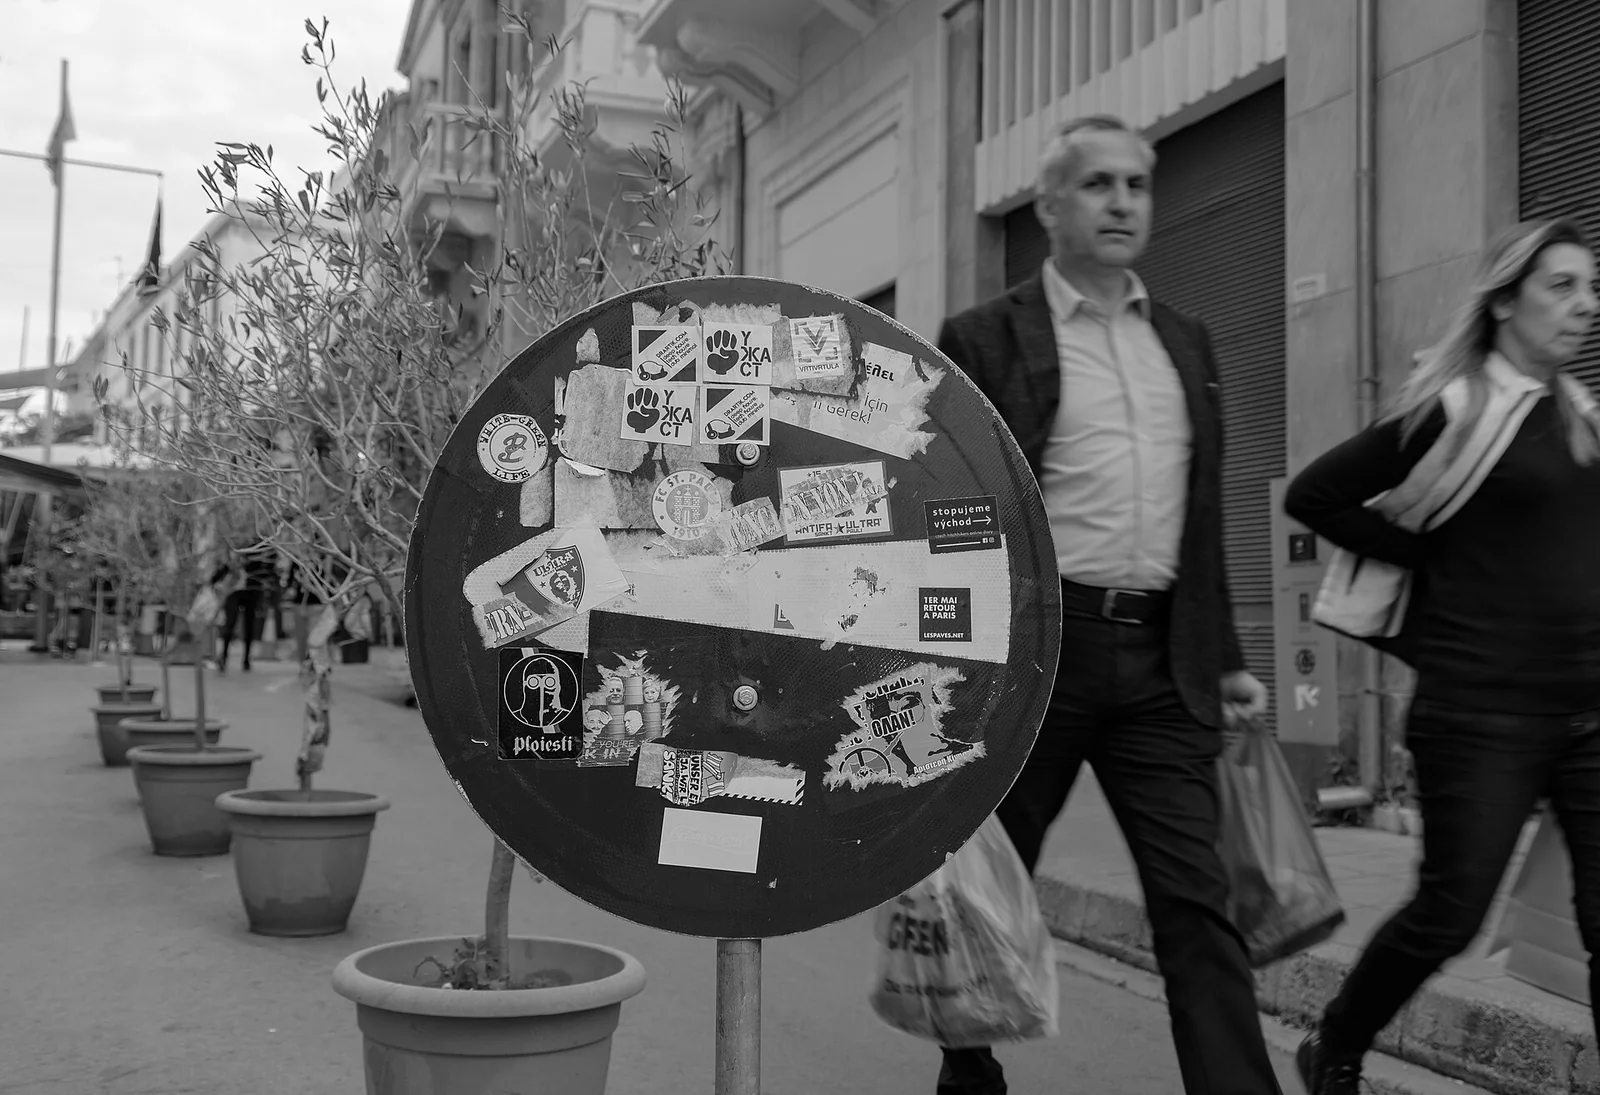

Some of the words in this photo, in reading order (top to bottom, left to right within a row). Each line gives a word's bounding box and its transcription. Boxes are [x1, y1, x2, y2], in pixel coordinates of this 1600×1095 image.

[493, 467, 530, 480] LIFE
[932, 504, 991, 517] stopujeme
[934, 517, 972, 530] východ
[940, 596, 957, 604] MAI
[923, 604, 956, 612] RETOUR
[513, 735, 573, 755] Ploiesti
[690, 756, 700, 790] UNSER
